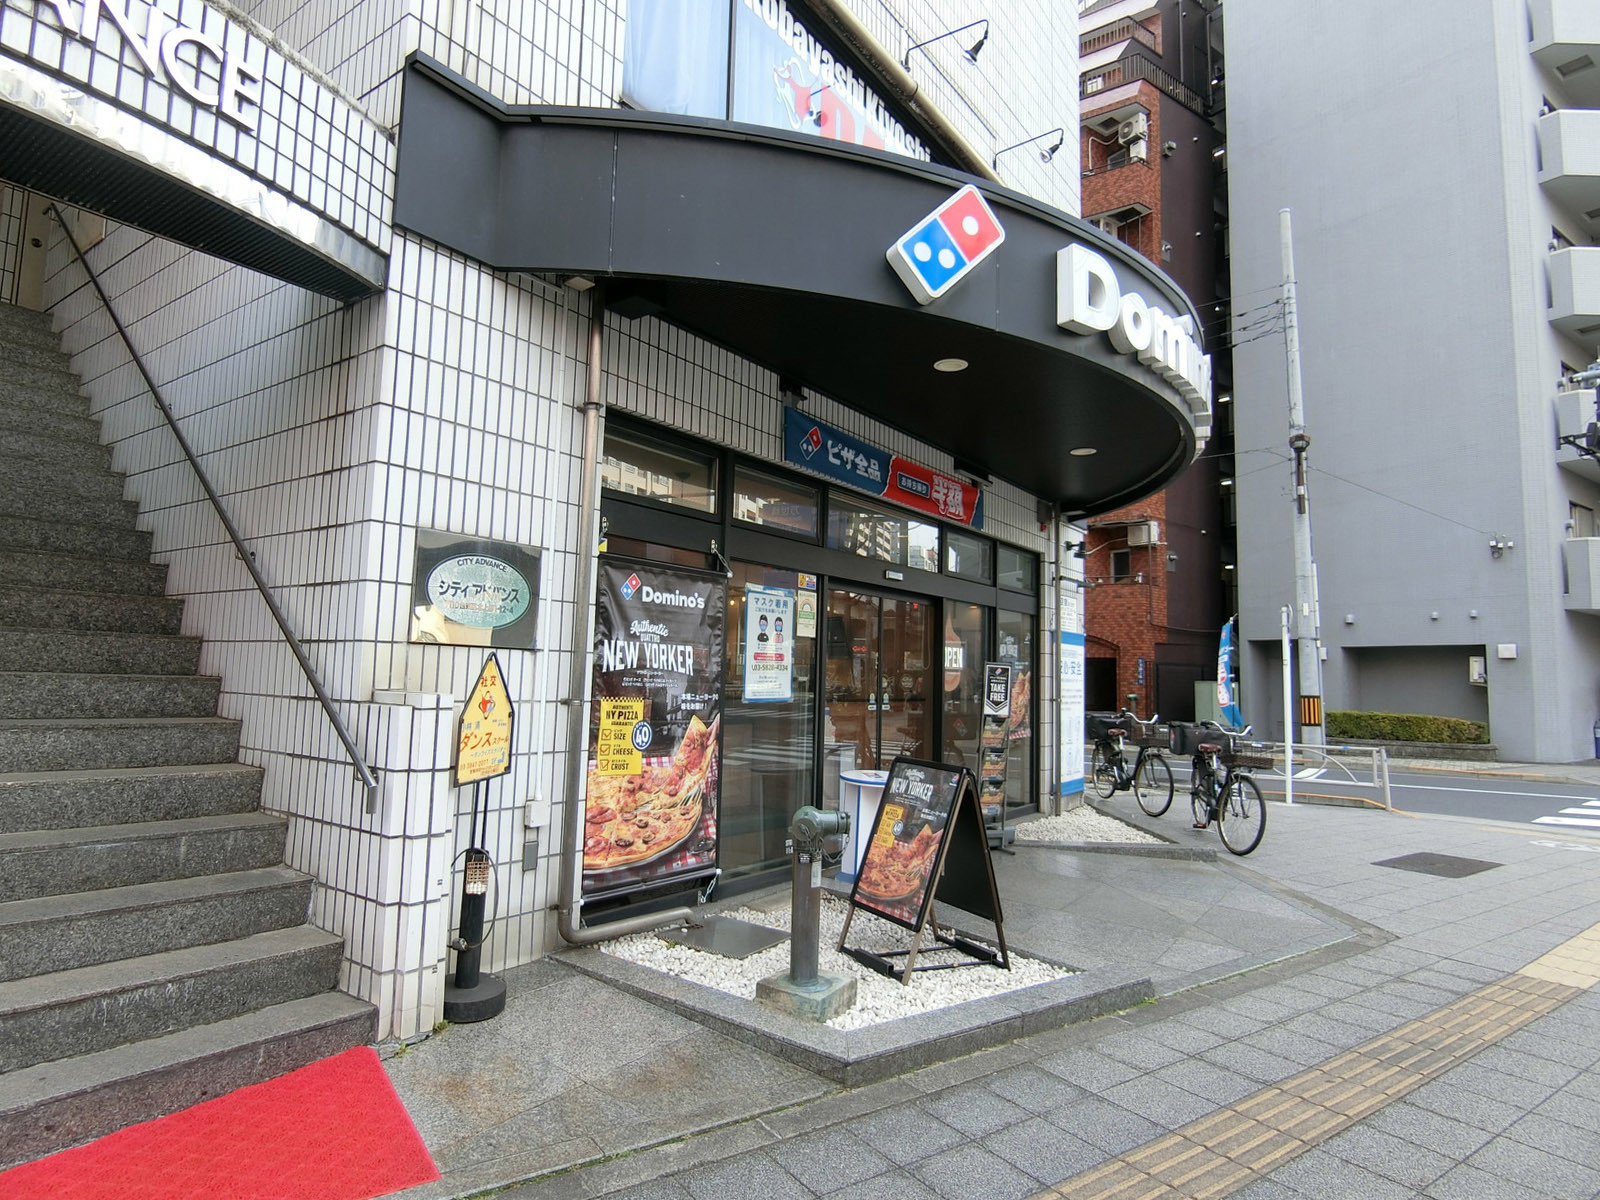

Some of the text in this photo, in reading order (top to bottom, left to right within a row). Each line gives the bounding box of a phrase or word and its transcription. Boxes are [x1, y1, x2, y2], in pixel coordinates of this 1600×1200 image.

[827, 440, 881, 483] ピザ全品
[932, 475, 965, 520] 半額
[457, 558, 508, 573] CITY ADVANCE
[641, 585, 705, 609] Domino's
[754, 597, 789, 609] マスク着用
[630, 619, 669, 637] Authentic
[602, 639, 694, 676] NEW YORKER
[481, 675, 497, 687] 社交
[990, 683, 1006, 693] TAKE
[990, 693, 1006, 702] FREE
[606, 711, 638, 721] NY PIZZA
[460, 732, 492, 753] ダンス
[613, 732, 626, 741] SIZE
[613, 748, 633, 756] CHEESE
[611, 763, 629, 771] CRUST
[889, 778, 909, 794] NEW
[908, 780, 934, 803] YORKER
